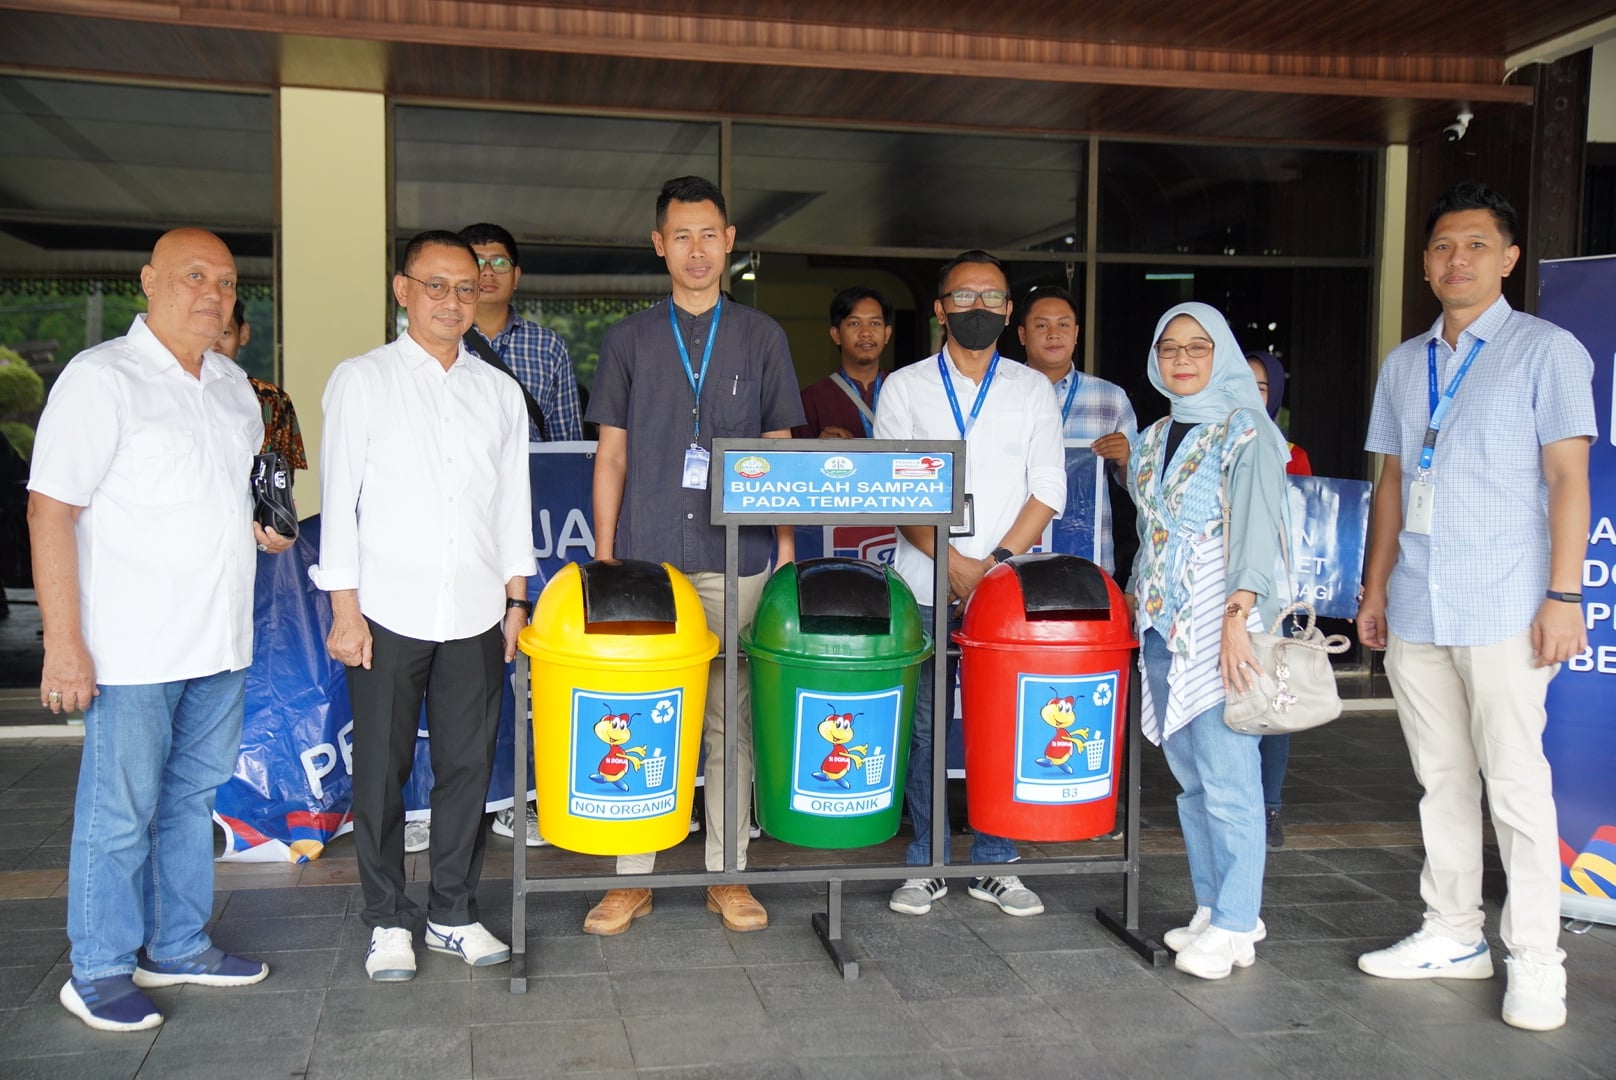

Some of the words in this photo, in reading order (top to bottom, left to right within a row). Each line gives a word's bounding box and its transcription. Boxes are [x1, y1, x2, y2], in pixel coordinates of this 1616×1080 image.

[730, 481, 850, 493] BUANGLAH
[857, 481, 944, 493] SAMPAH
[742, 496, 801, 508] PADA
[806, 496, 933, 508] TEMPATNYA
[1062, 788, 1078, 798] B3
[575, 801, 606, 814] NON
[610, 798, 672, 815] ORGANIK
[811, 798, 879, 812] ORGANIK
